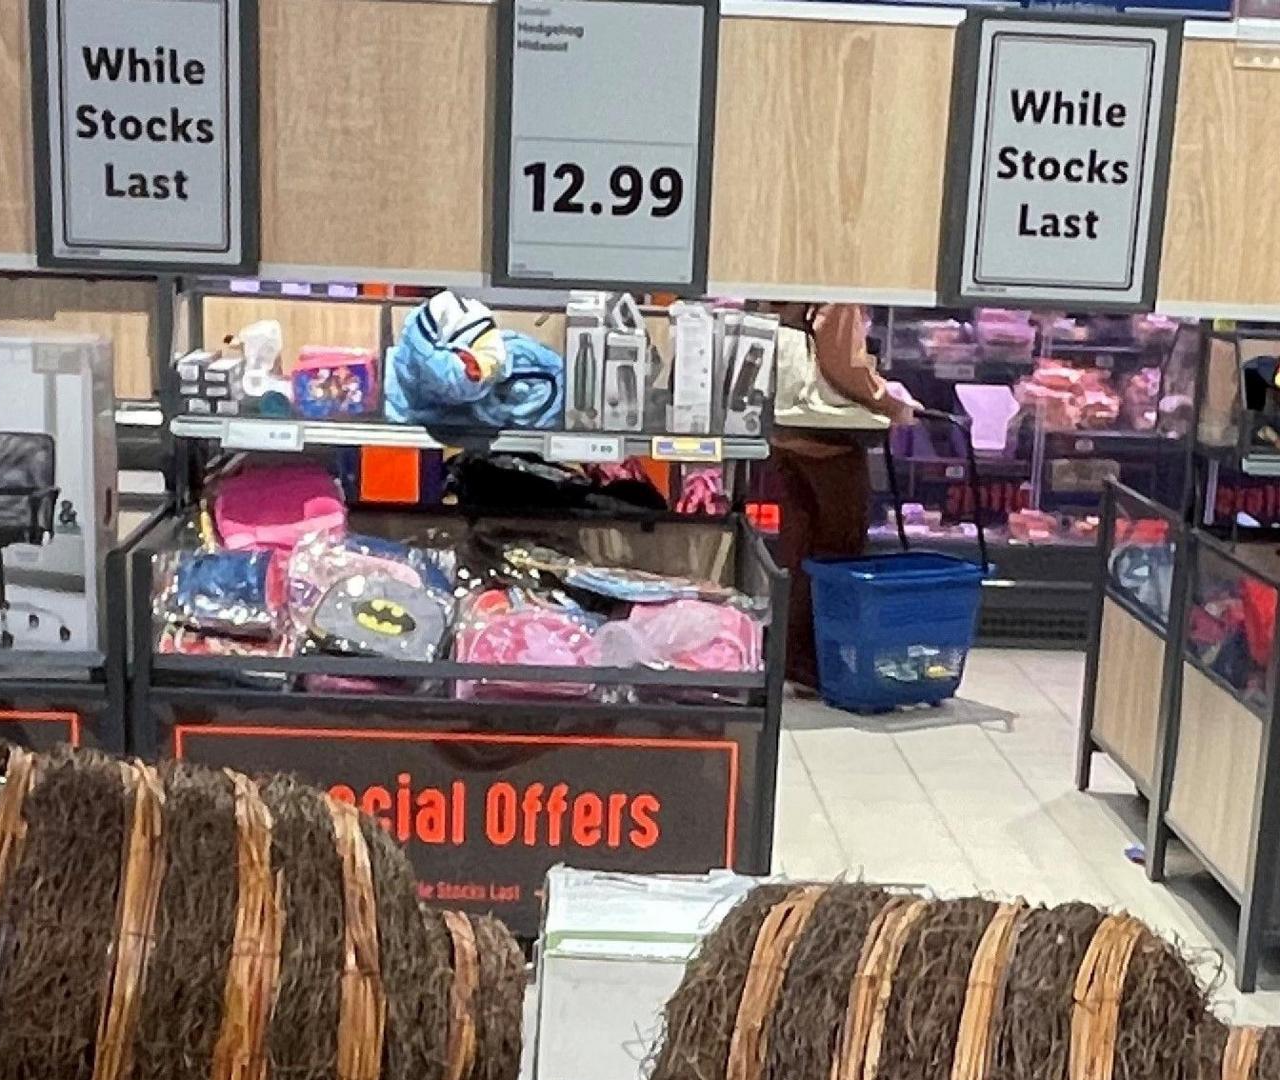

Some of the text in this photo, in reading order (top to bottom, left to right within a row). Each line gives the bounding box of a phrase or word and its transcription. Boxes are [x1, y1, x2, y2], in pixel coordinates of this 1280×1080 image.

[518, 20, 585, 38] Hedgehog
[82, 45, 207, 86] While
[75, 103, 215, 145] Stocks
[1010, 89, 1127, 129] While
[104, 161, 190, 202] Last
[996, 147, 1129, 185] Stocks
[521, 160, 685, 219] 12.99
[1017, 203, 1099, 241] Last
[485, 781, 661, 849] Offers
[436, 882, 486, 900] Stocks
[489, 881, 520, 901] Last
